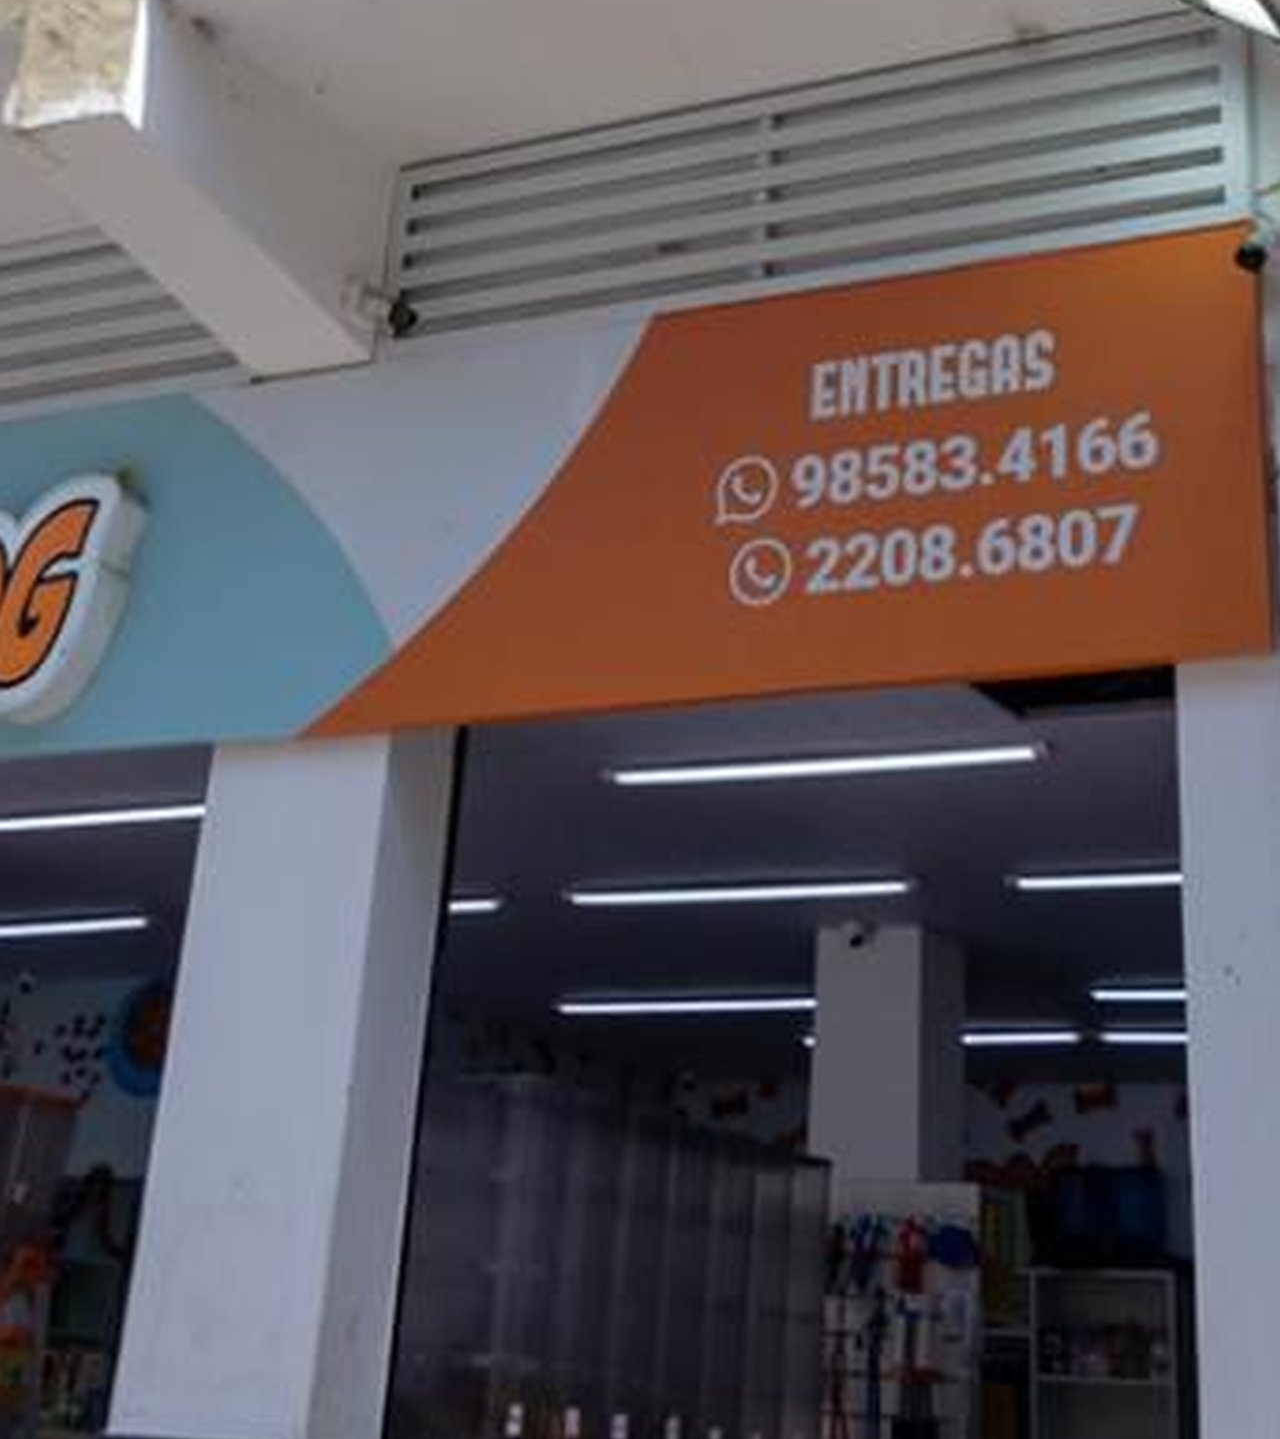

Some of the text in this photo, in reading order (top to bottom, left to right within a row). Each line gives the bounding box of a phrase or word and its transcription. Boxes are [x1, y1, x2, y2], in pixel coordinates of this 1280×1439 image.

[809, 330, 1057, 421] ENTREGAS
[791, 411, 1160, 509] 98583.4166
[805, 503, 1140, 594] 2208.6807
